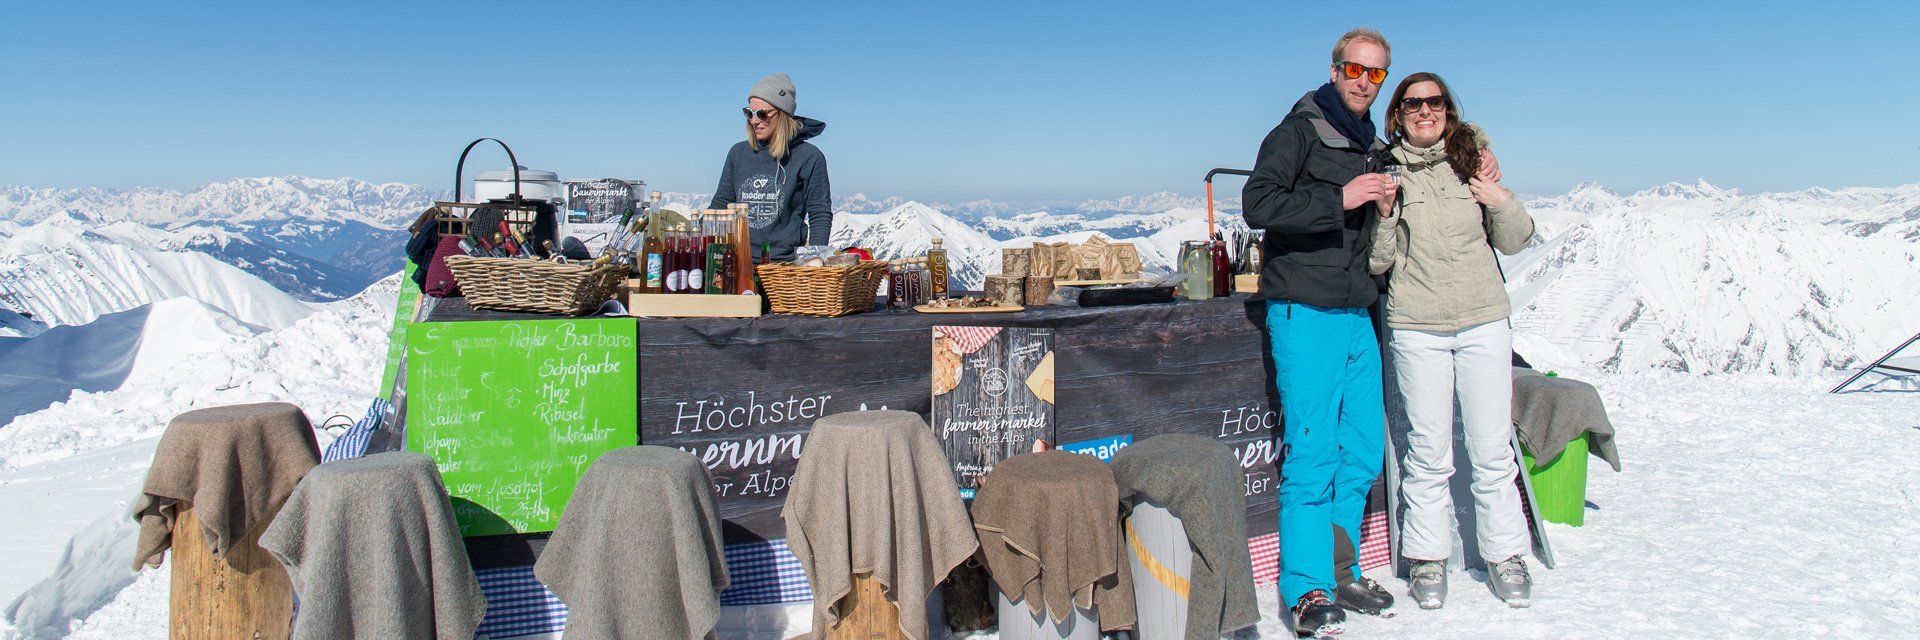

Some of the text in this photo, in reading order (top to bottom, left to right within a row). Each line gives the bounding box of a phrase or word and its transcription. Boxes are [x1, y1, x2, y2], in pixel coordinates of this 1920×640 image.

[573, 185, 629, 198] Bauernmarkt
[538, 351, 621, 388] Schafgarbe
[671, 391, 832, 434] Höchster
[956, 402, 1029, 418] The highest
[943, 412, 1046, 440] farmer's market
[968, 431, 1025, 445] in the Alps
